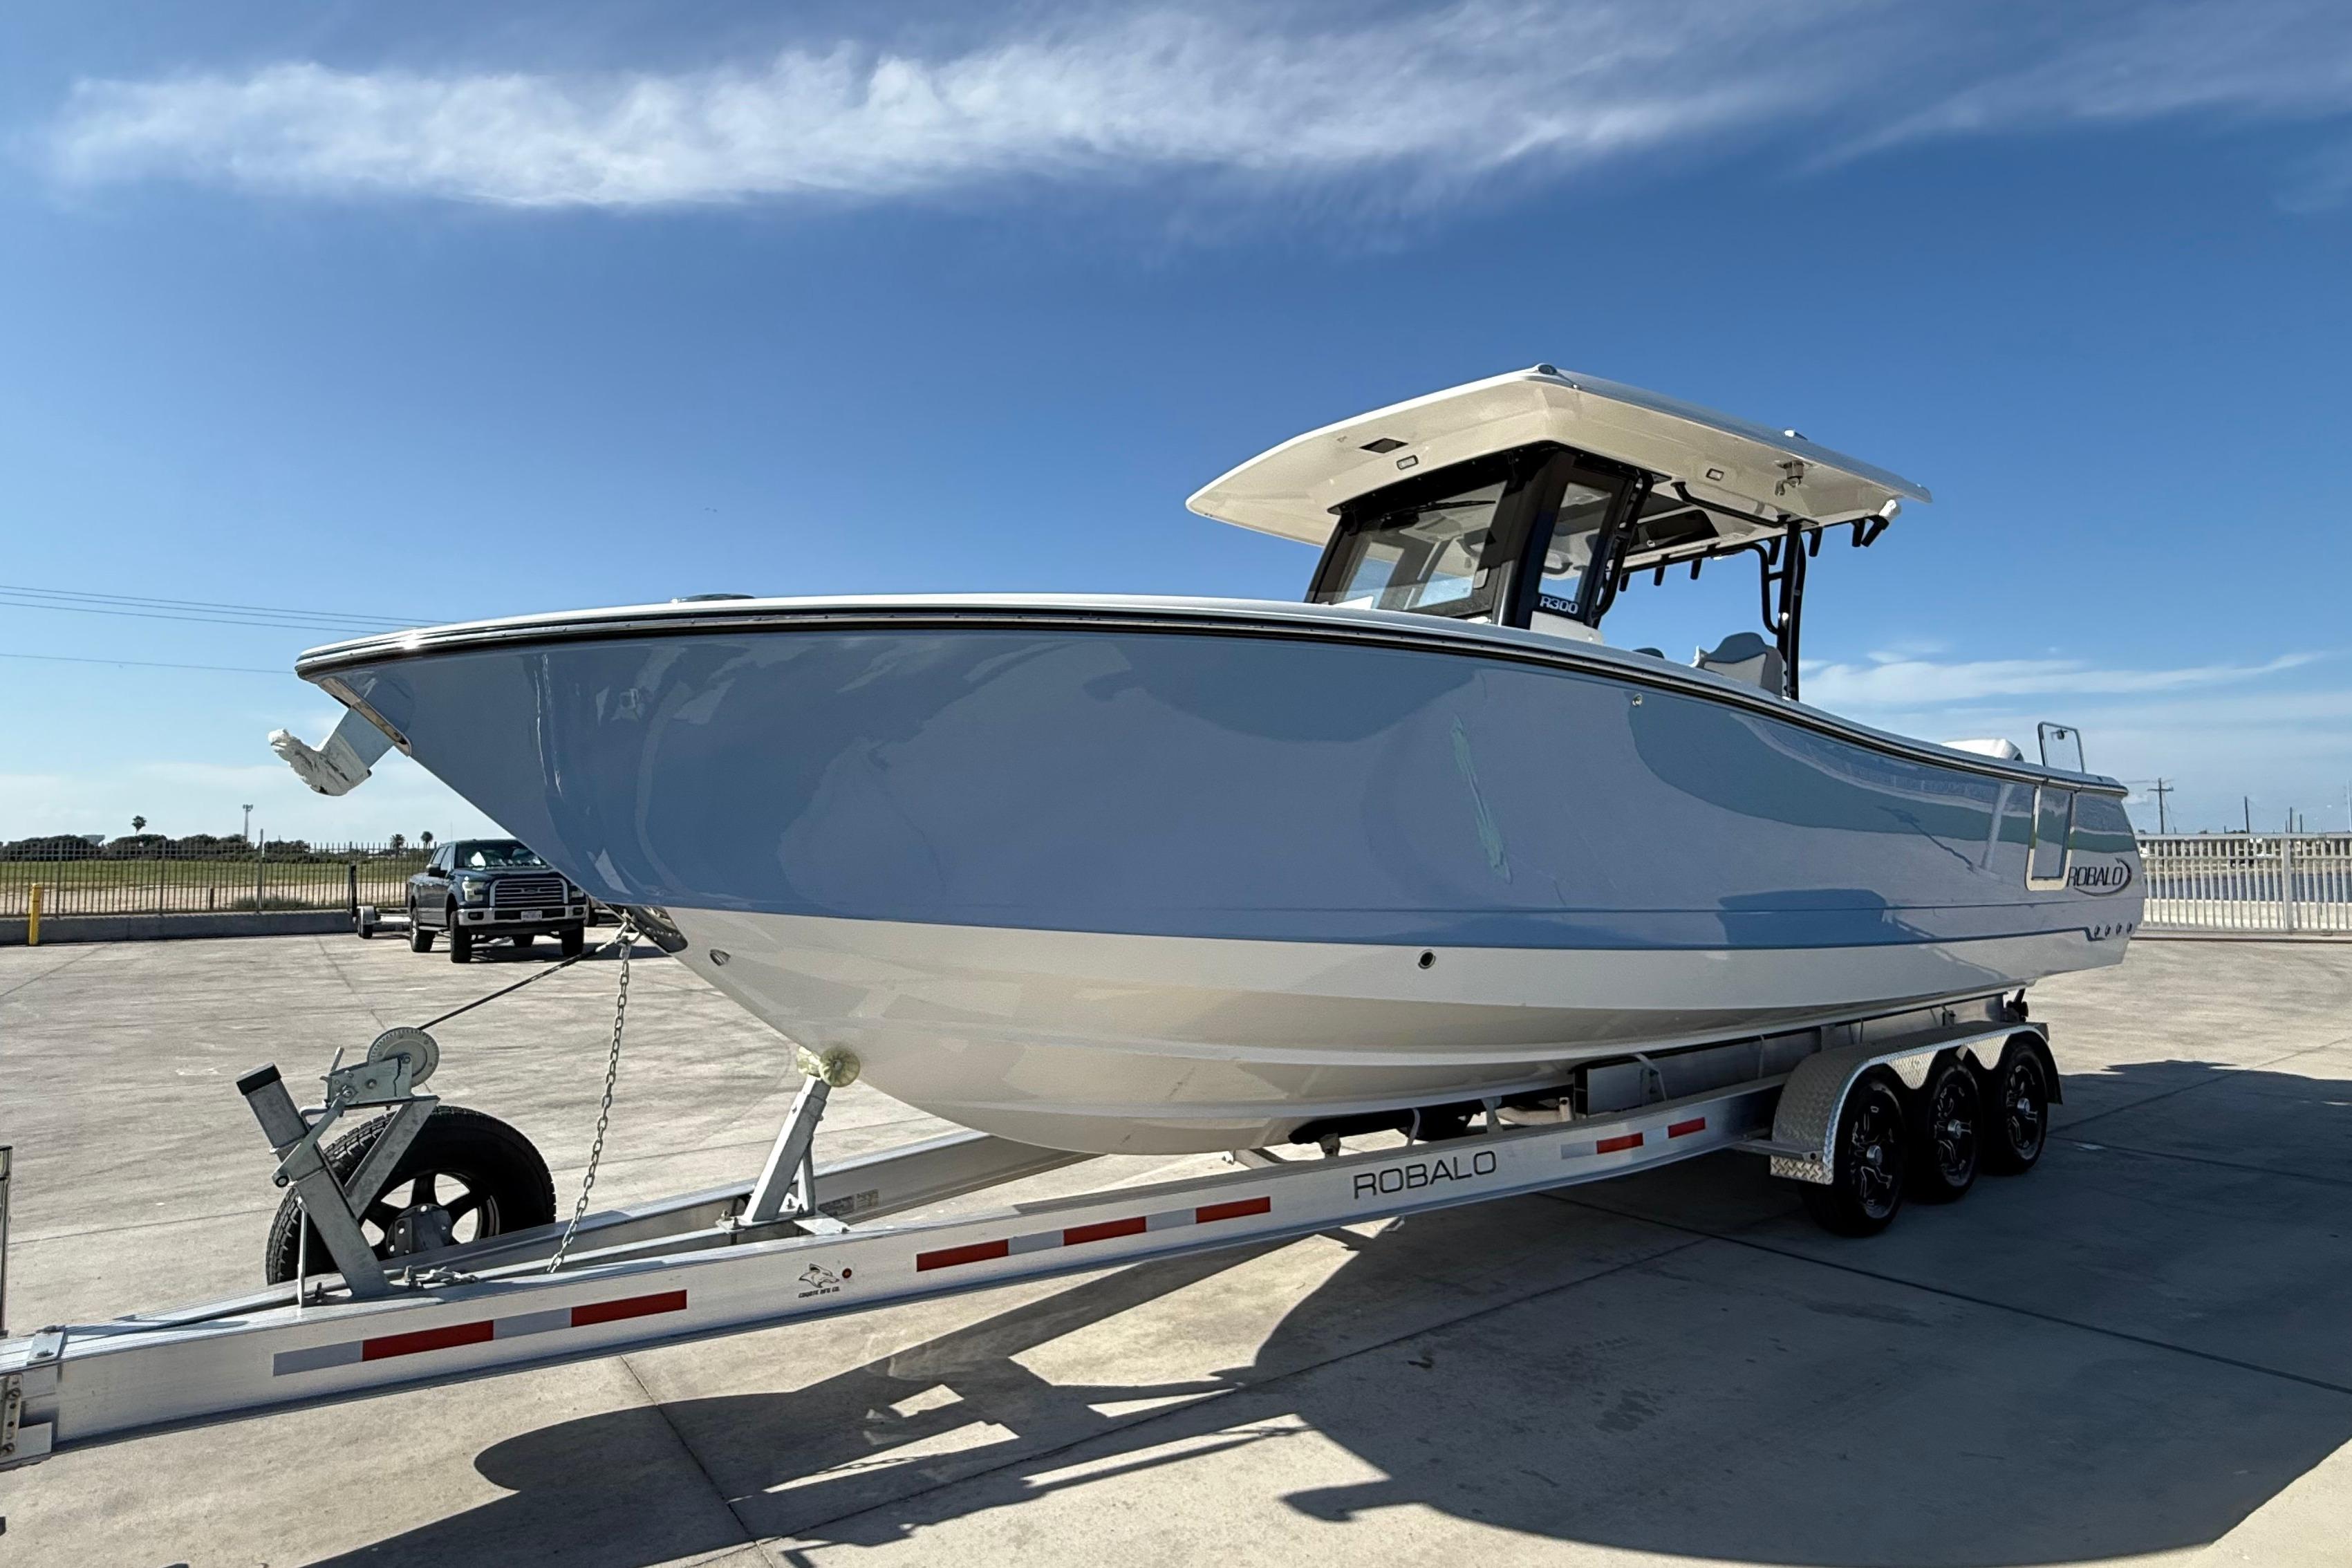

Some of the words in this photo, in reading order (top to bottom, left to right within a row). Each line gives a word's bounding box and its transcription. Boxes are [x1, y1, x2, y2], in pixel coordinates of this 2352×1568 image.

[1539, 595, 1579, 615] R300
[2066, 865, 2124, 888] ROBALO
[1353, 1150, 1497, 1200] ROBALO
